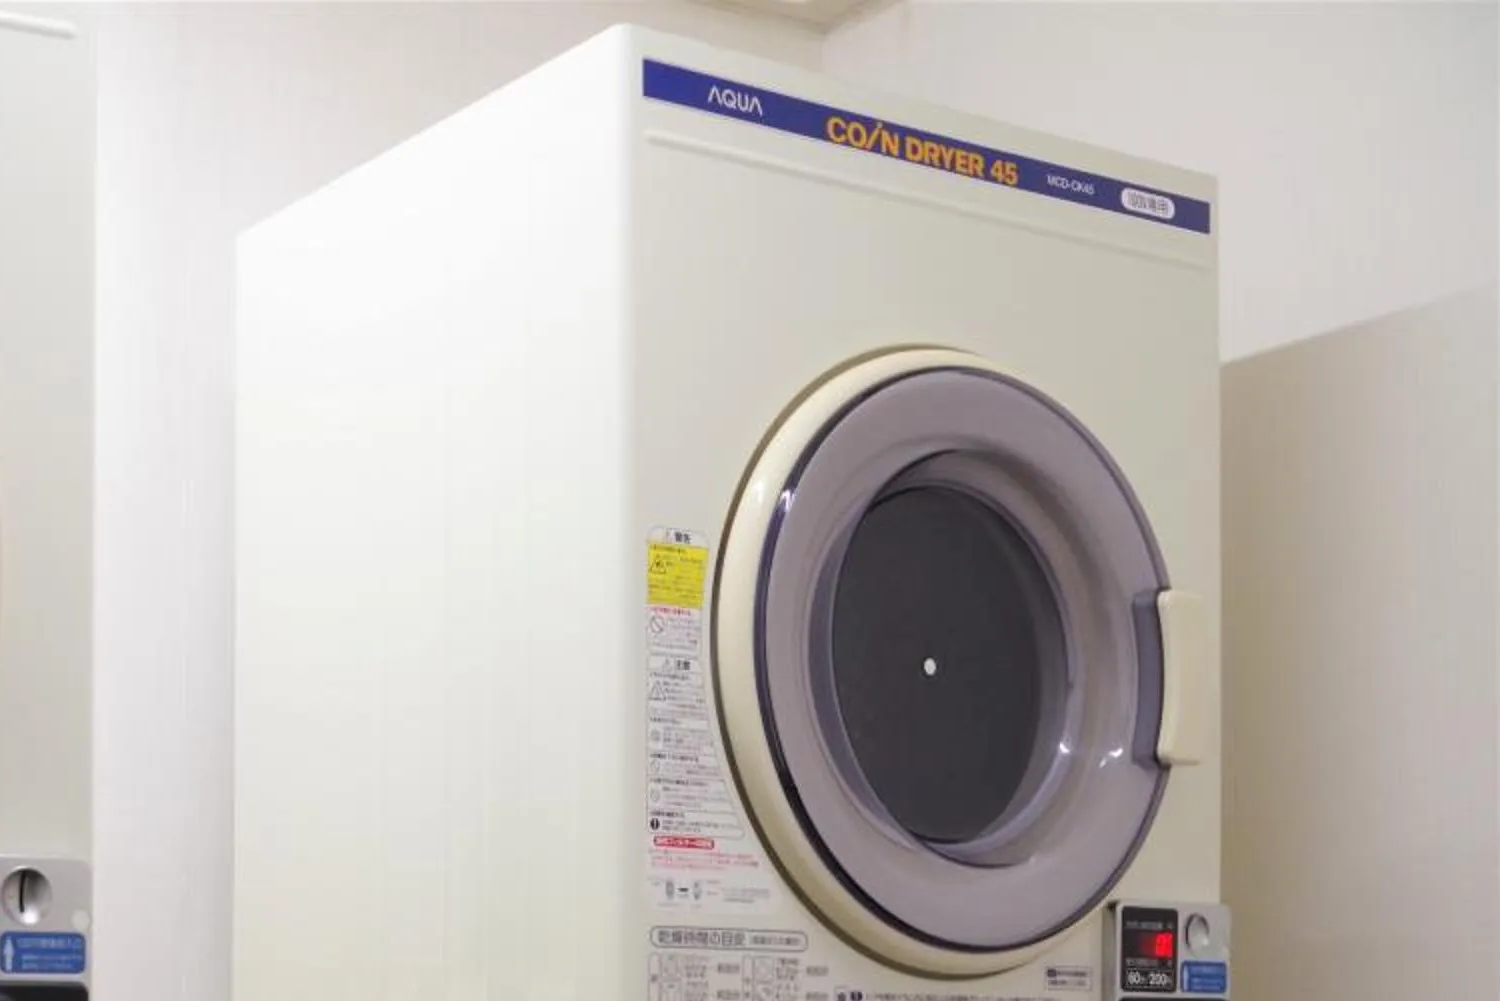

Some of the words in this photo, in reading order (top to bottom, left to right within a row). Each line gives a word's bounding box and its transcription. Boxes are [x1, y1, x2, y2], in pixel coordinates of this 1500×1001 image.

[707, 84, 764, 117] AQUA
[826, 115, 900, 157] COIN
[904, 135, 985, 178] DRYER
[989, 158, 1020, 186] 45
